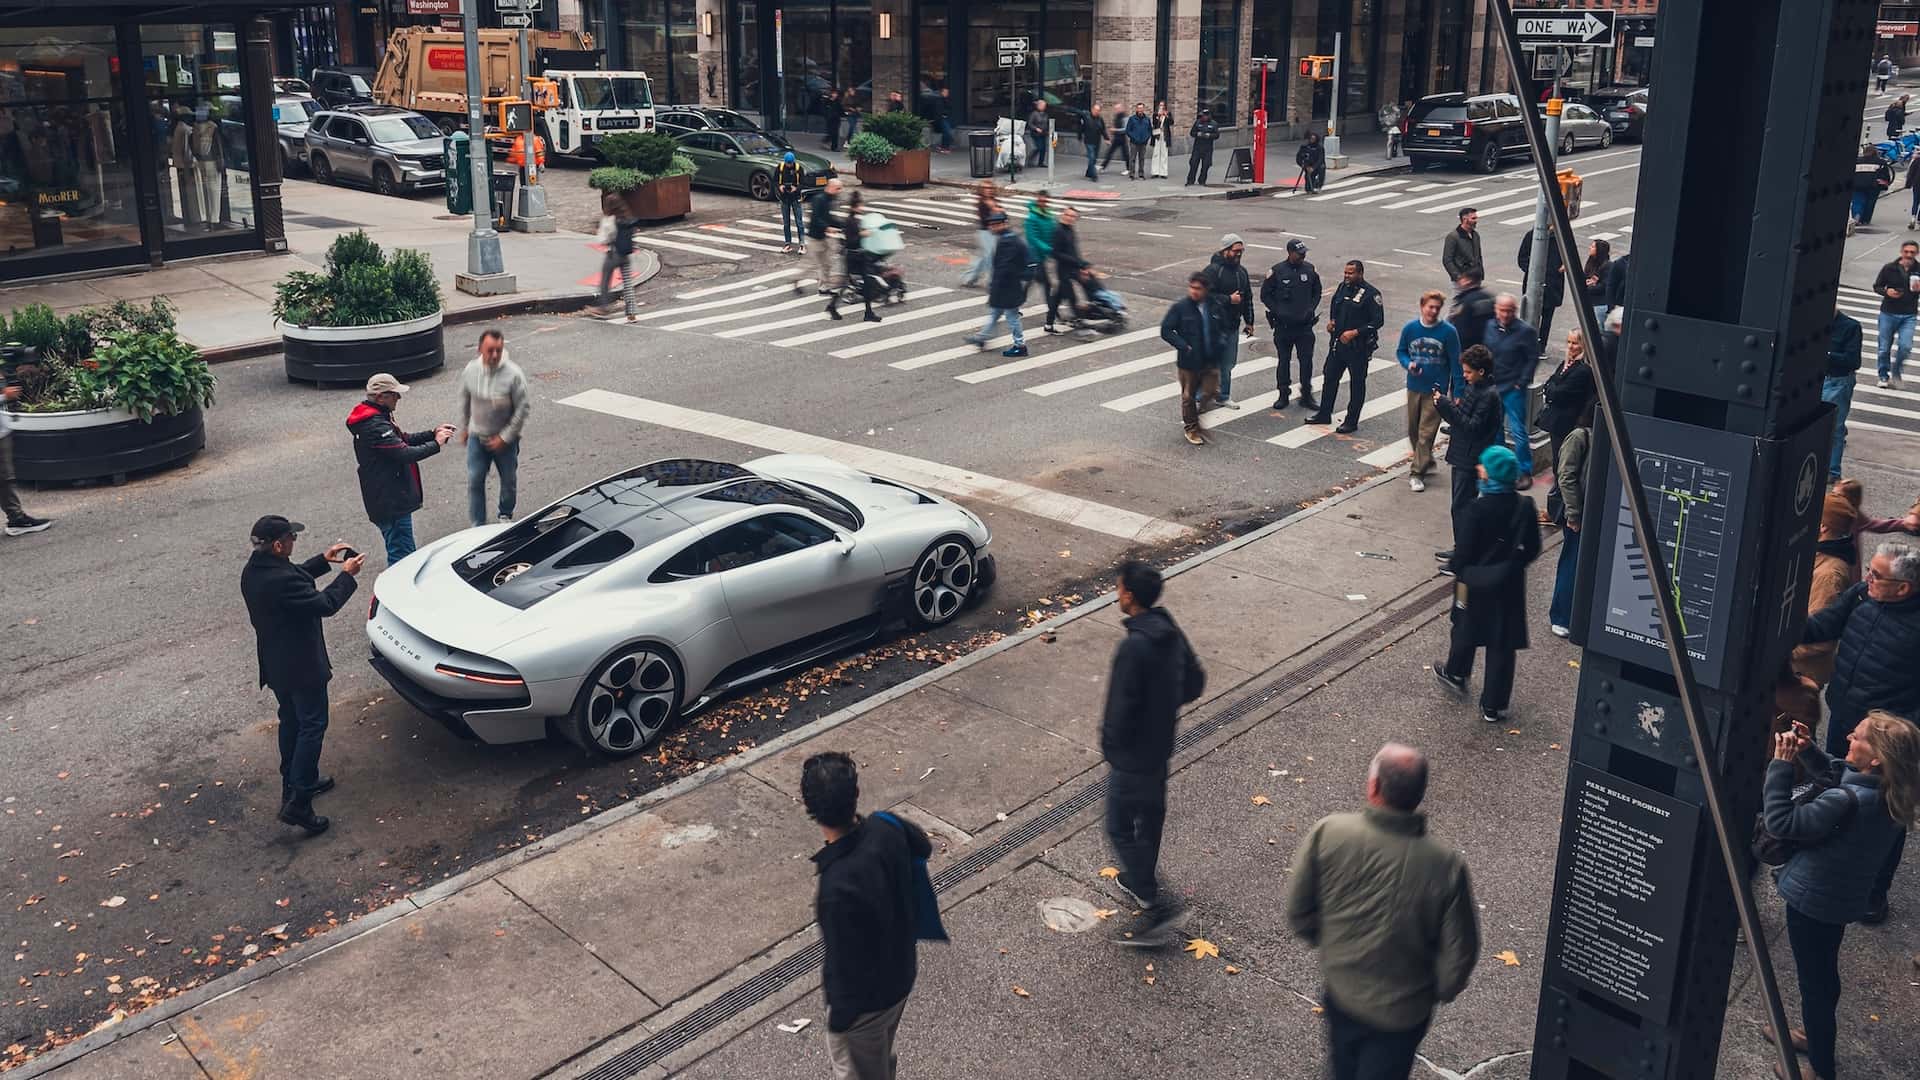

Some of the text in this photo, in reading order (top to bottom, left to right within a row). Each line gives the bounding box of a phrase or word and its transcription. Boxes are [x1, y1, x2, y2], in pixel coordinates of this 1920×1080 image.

[410, 0, 448, 11] Washington
[1525, 20, 1596, 34] ONE WAY
[377, 625, 421, 660] PORSCHE
[1605, 626, 1625, 636] HIGH
[1626, 632, 1646, 642] LINE
[1584, 800, 1606, 812] Bicycles
[1586, 780, 1670, 817] PARK RULES PROHIBIT
[1586, 791, 1609, 806] Smoking
[1582, 816, 1592, 824] Use
[1599, 815, 1618, 826] except
[1628, 827, 1648, 837] service
[1649, 835, 1663, 844] dogs
[1580, 830, 1601, 844] Walking
[1609, 843, 1631, 856] planting
[1632, 852, 1646, 862] beds
[1588, 826, 1621, 842] recreational
[1622, 840, 1645, 853] scooters
[1578, 845, 1596, 858] Picking
[1598, 853, 1618, 865] flowers
[1626, 866, 1643, 876] plants
[1595, 845, 1618, 857] exposed
[1629, 858, 1646, 868] tracks
[1574, 868, 1597, 882] Drinking
[1620, 888, 1639, 899] except
[1577, 853, 1594, 865] Sitting
[1603, 865, 1623, 877] railings
[1631, 877, 1656, 891] climbing
[1625, 880, 1639, 890] High
[1640, 887, 1652, 896] Line
